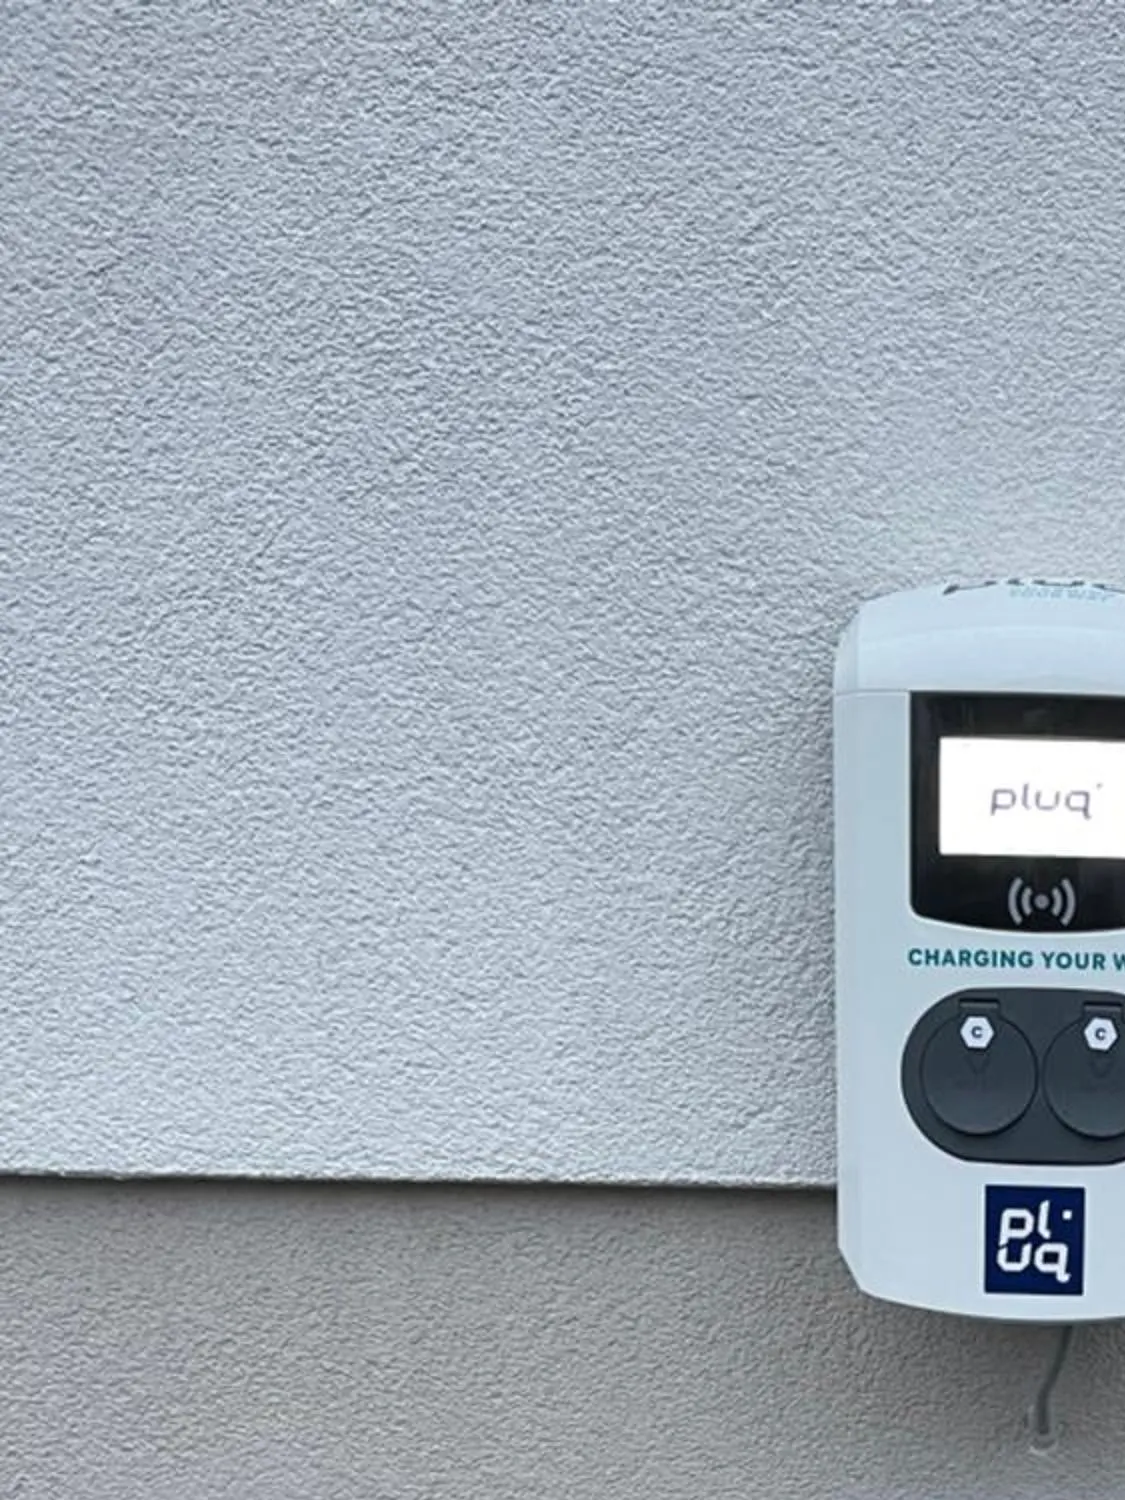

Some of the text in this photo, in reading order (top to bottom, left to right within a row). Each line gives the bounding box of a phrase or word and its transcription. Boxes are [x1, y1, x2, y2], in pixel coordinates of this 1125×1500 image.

[907, 948, 1034, 968] CHARGING
[1041, 951, 1106, 970] YOUR
[970, 1026, 984, 1039] C
[1094, 1028, 1108, 1041] C
